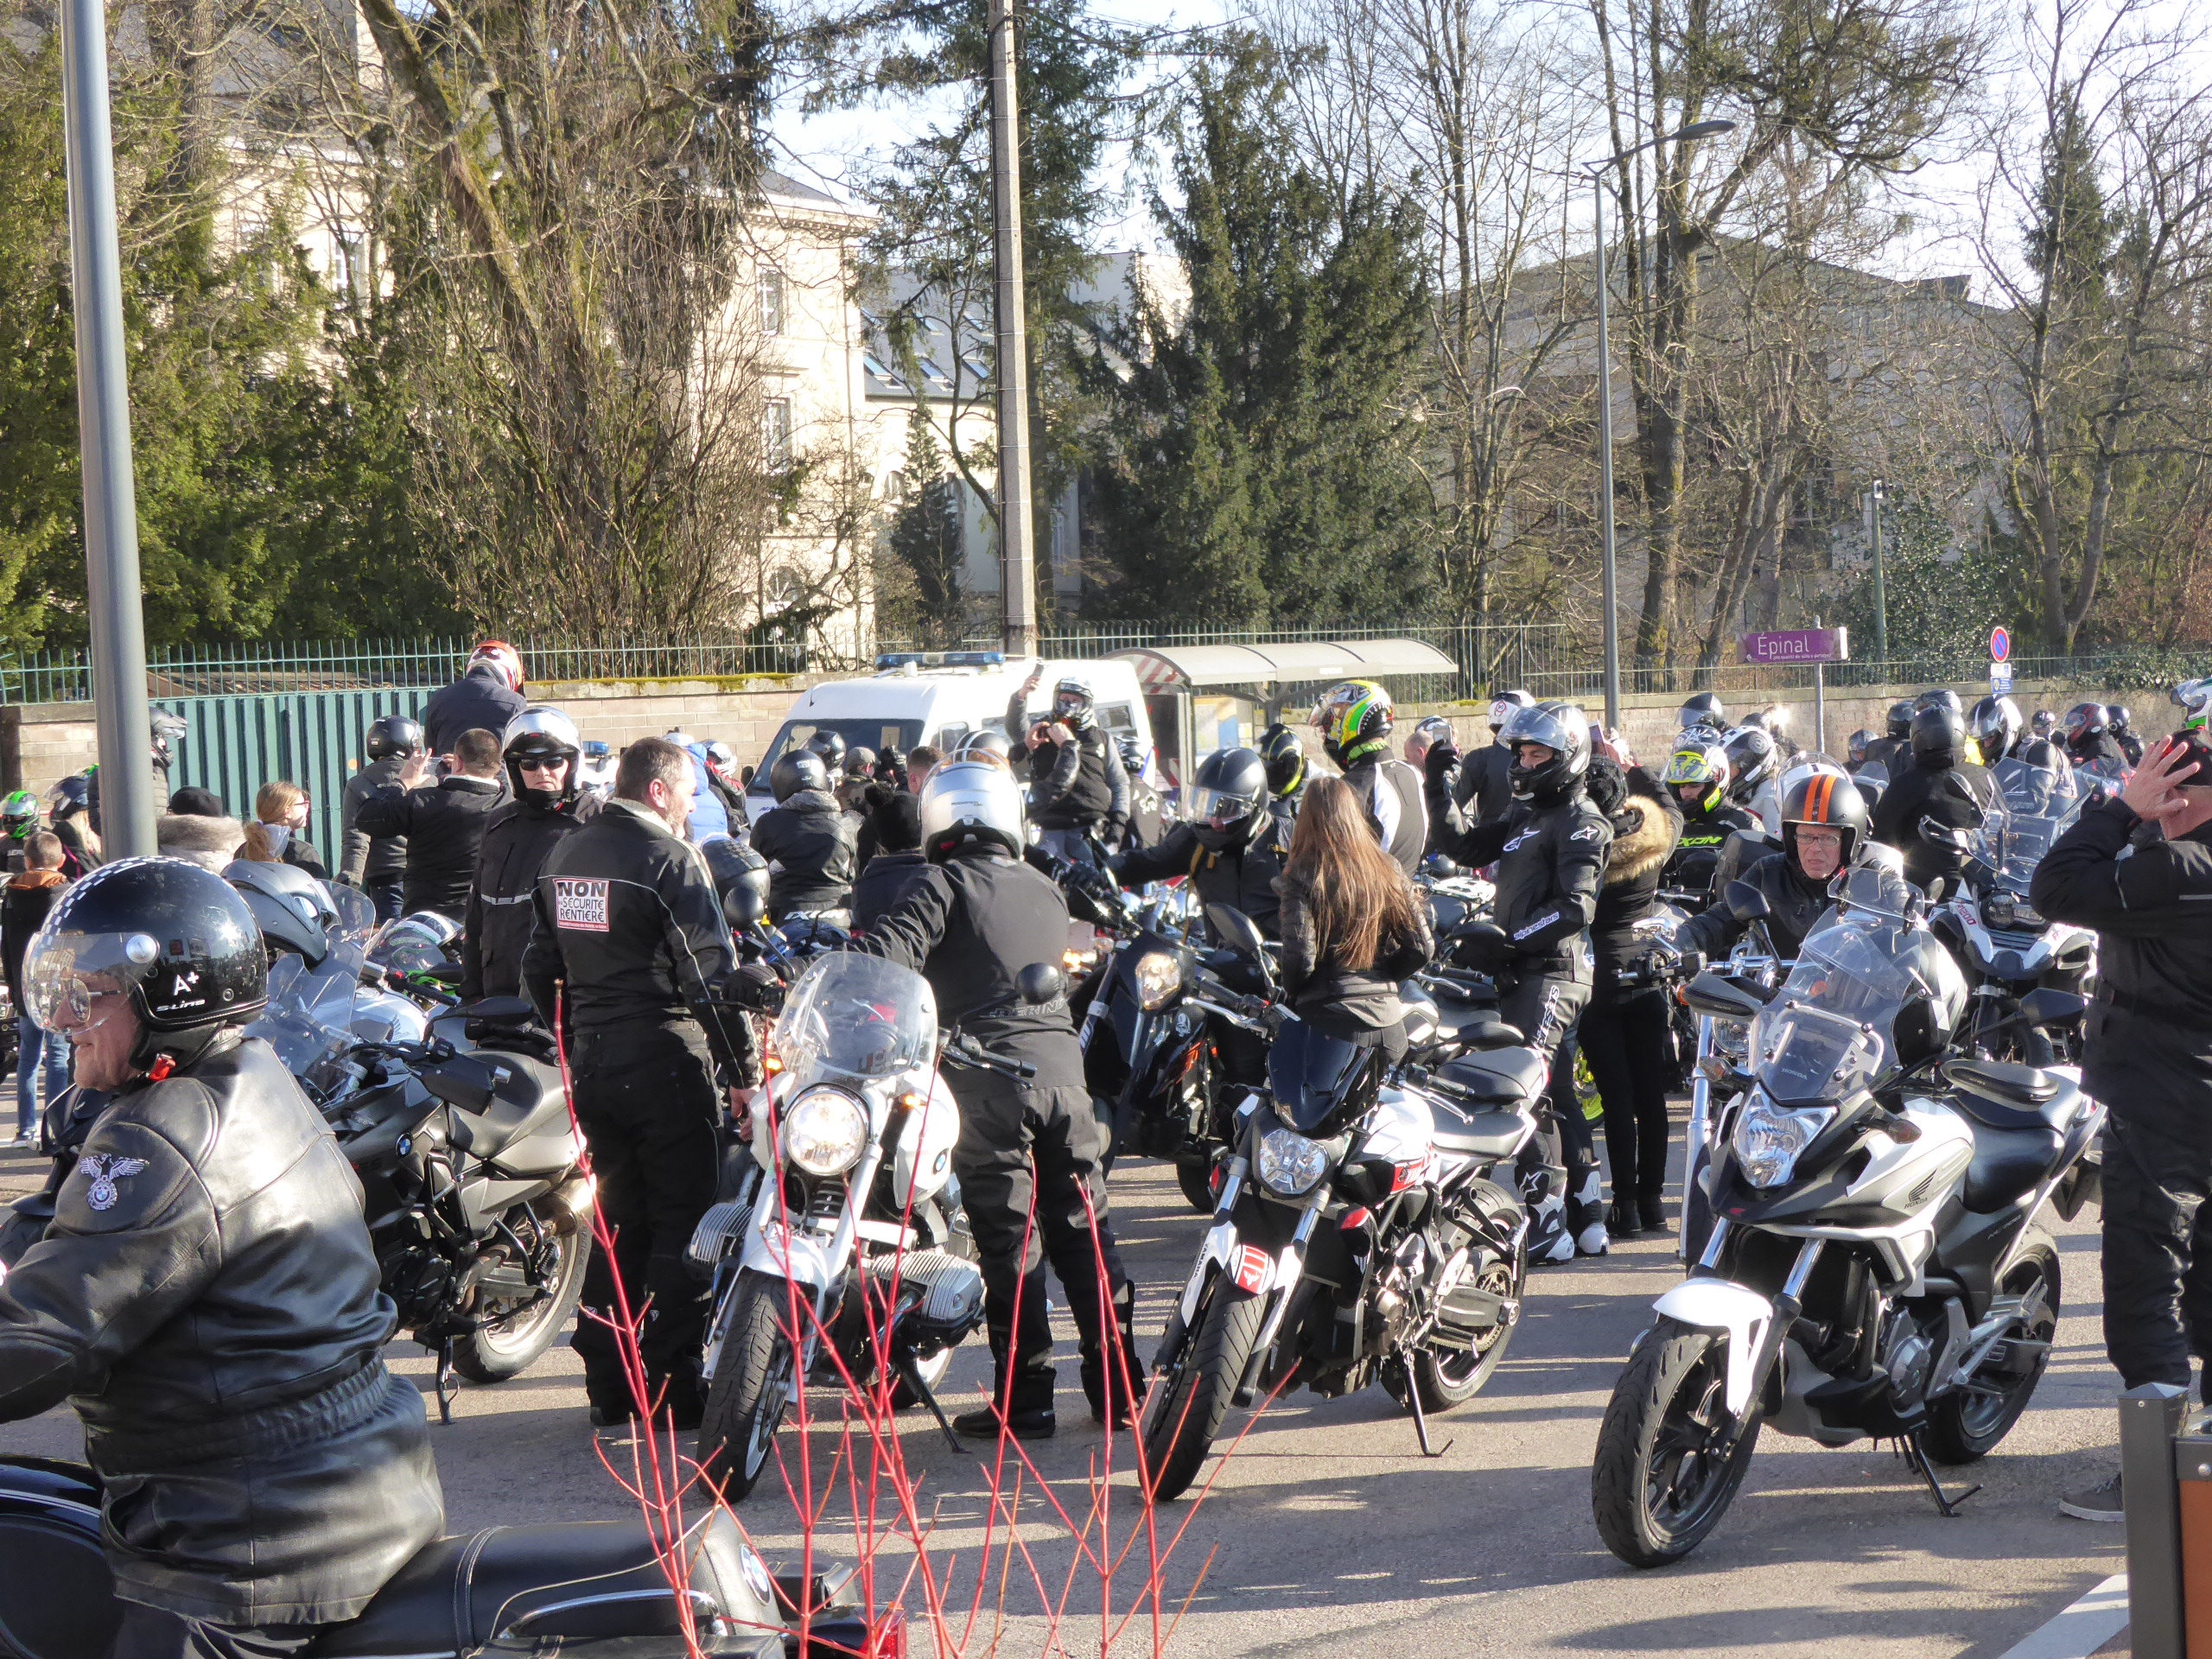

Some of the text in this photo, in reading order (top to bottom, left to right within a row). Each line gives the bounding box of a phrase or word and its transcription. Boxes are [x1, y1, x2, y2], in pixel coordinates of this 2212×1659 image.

[1758, 632, 1809, 659] Épinal
[1678, 836, 1722, 847] XON
[557, 881, 606, 897] NON
[1514, 912, 1560, 941] alpinestars
[1782, 1068, 1808, 1079] HONDA
[1904, 1198, 1928, 1209] HONDA
[1193, 1243, 1210, 1278] YAMAHA
